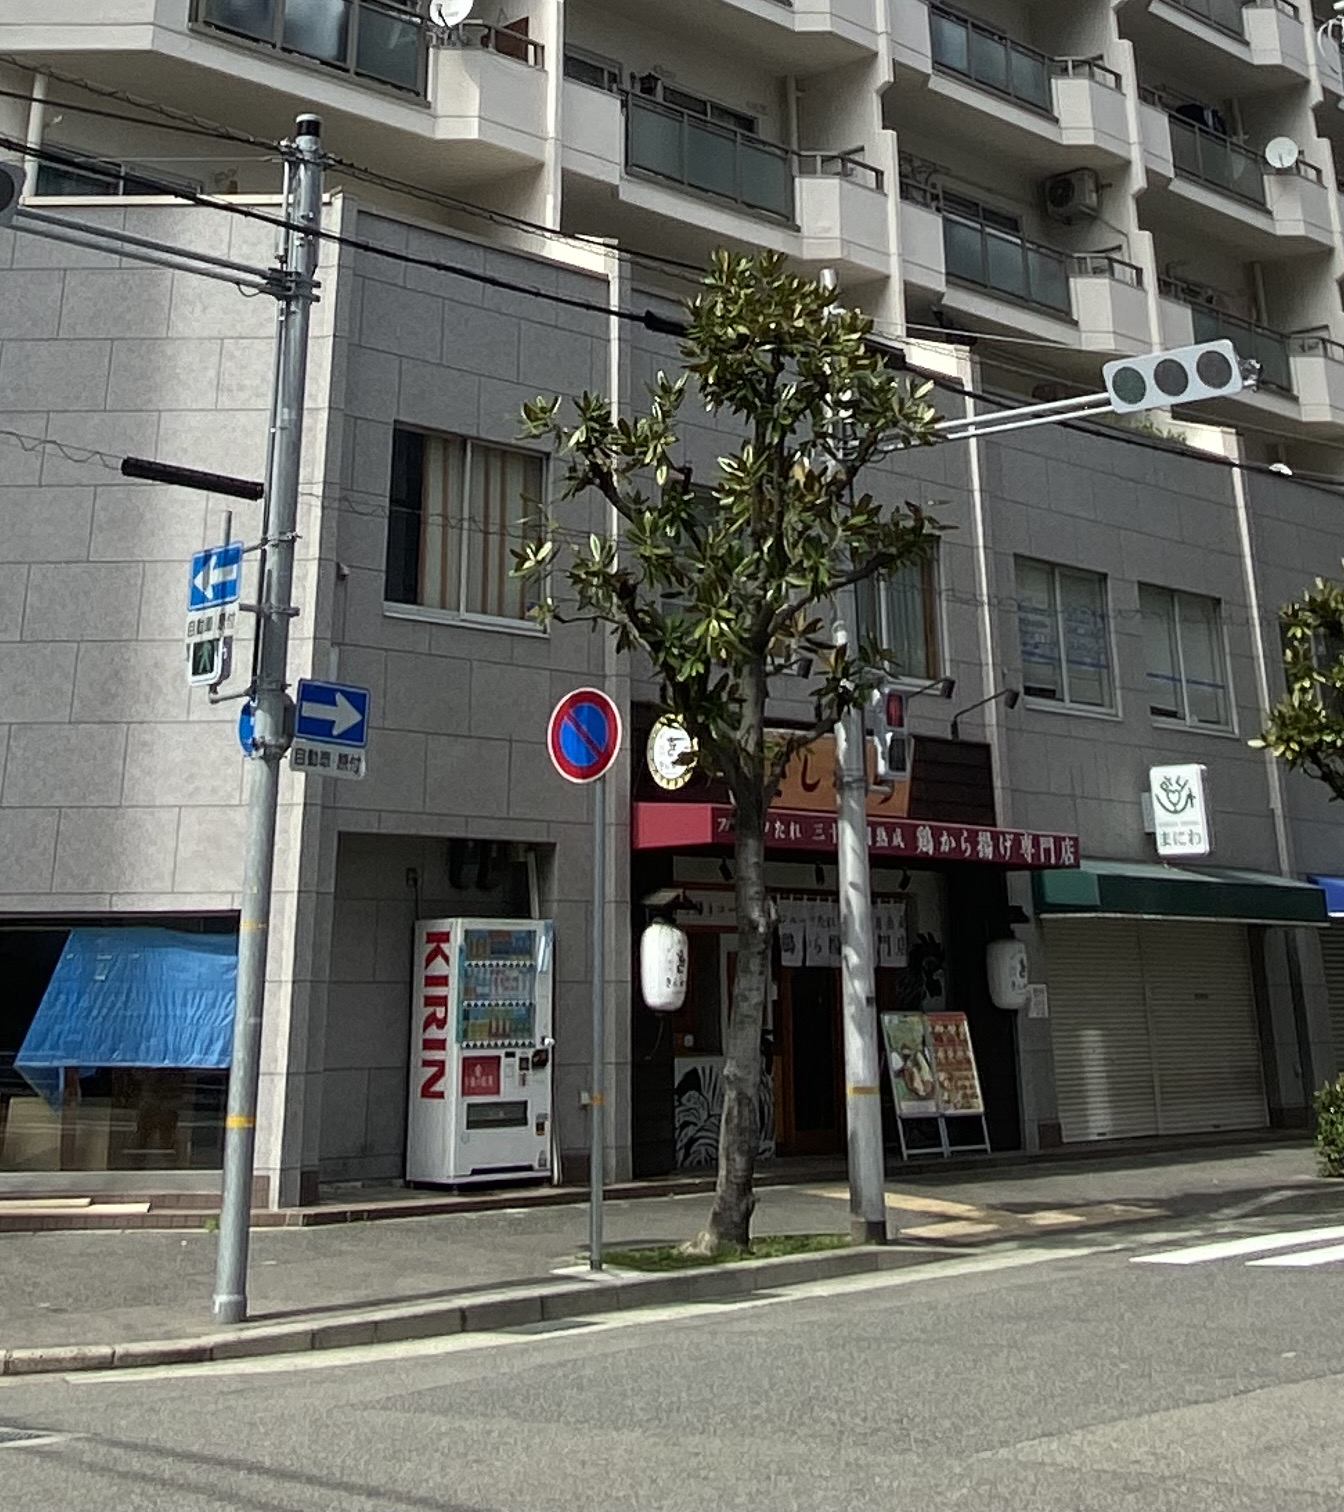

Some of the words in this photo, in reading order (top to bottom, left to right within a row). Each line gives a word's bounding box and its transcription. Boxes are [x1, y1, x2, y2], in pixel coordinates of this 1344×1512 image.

[1160, 829, 1202, 846] まにわ
[420, 930, 452, 1100] KIRIN
